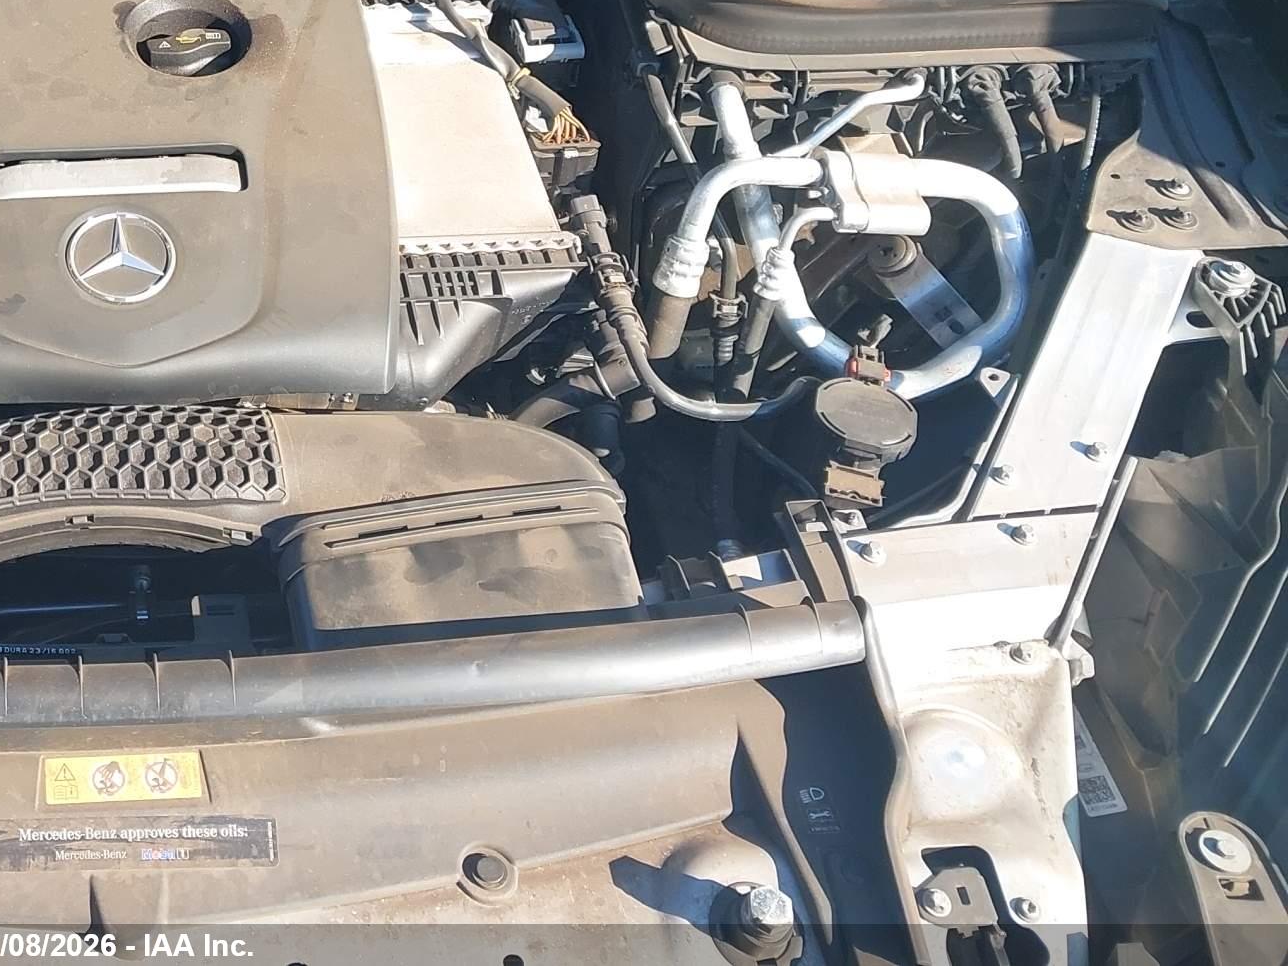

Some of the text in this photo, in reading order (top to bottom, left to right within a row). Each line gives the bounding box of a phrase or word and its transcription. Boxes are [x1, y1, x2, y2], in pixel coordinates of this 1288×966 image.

[18, 824, 249, 842] Mercedes-Benz approves these oils:
[55, 849, 127, 860] Mercedes-Benz
